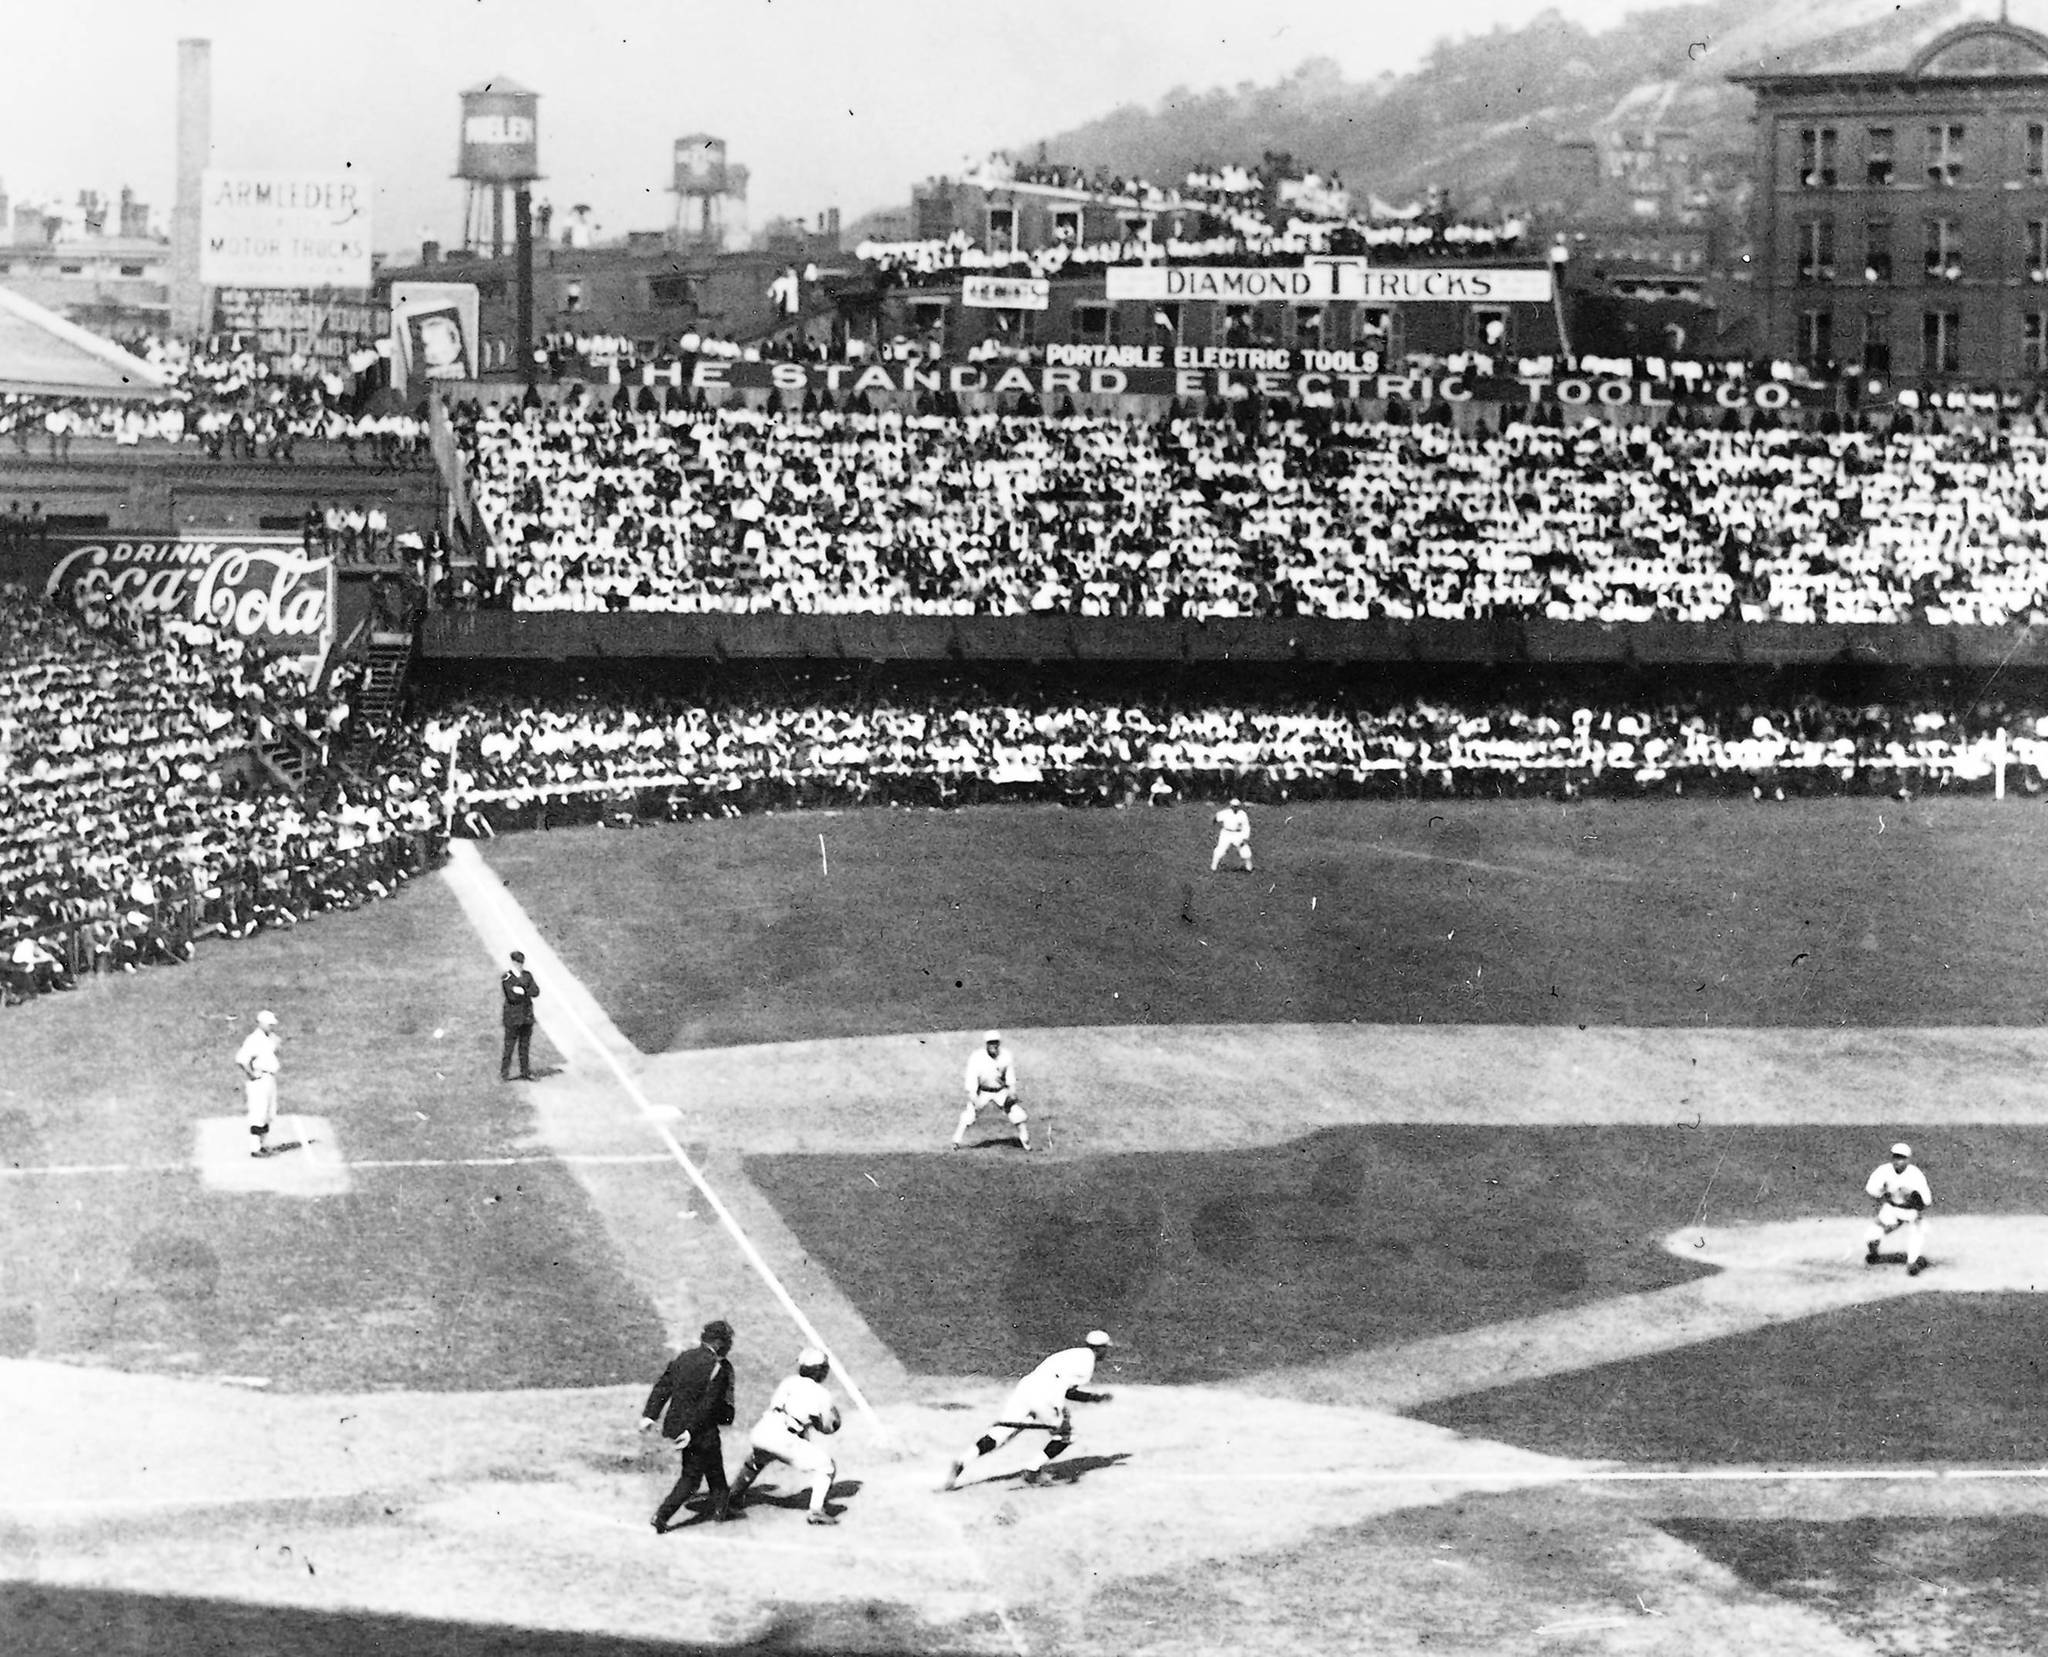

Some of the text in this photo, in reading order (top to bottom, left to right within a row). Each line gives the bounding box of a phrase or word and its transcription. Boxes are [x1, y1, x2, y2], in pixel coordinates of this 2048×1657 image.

[214, 181, 358, 218] ARMLEDER
[210, 237, 364, 260] MOTOR TRUCKS
[1167, 271, 1311, 296] DIAMOND
[1313, 261, 1360, 295] T
[1360, 272, 1492, 296] TRUCKS
[1046, 344, 1379, 373] PORTABLE ELECTRIC TOOLS
[592, 357, 733, 388] THE
[771, 363, 1129, 393] STANDARD
[1176, 371, 1474, 402] ELECTRIC
[1517, 377, 1674, 407] TOOL
[112, 543, 217, 564] DRINK
[45, 545, 334, 636] Coca-Cola
